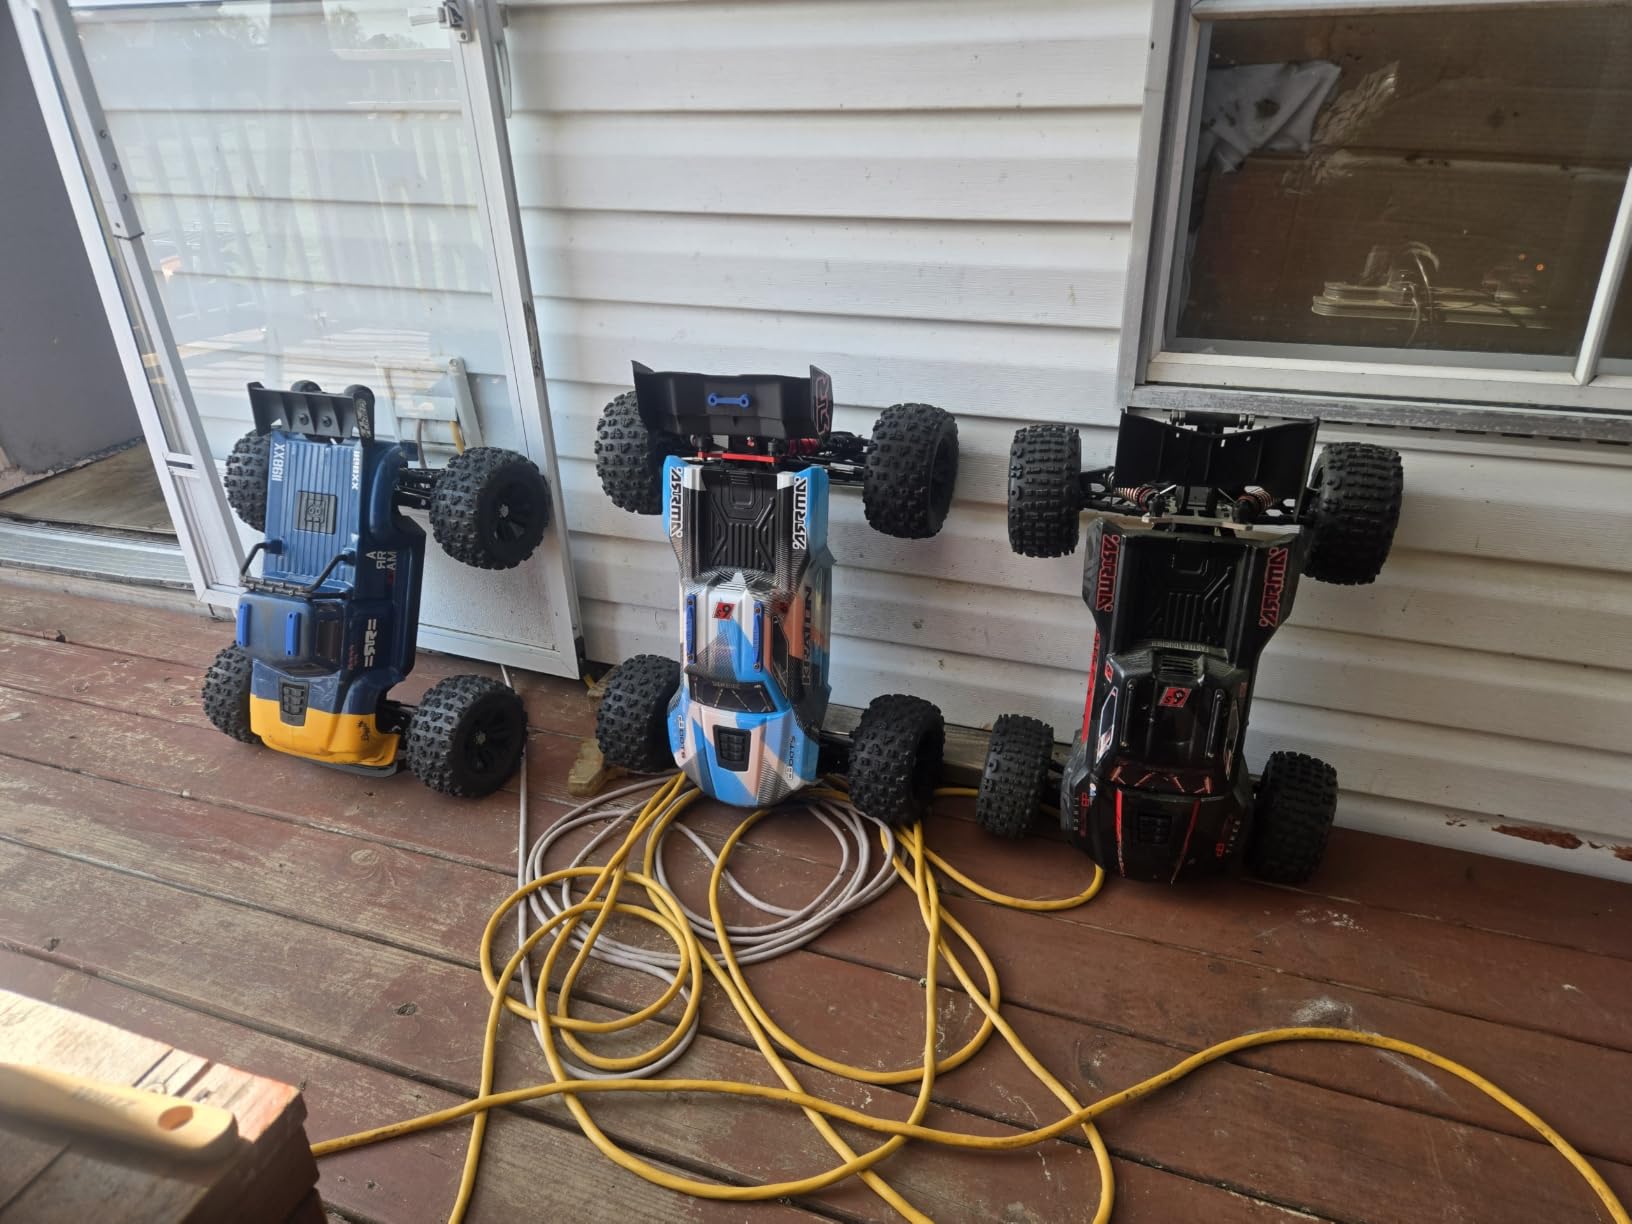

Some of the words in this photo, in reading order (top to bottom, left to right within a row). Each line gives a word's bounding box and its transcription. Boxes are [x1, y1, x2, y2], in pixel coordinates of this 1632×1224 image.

[669, 466, 684, 538] ARRMA
[792, 477, 807, 549] ARRMA
[1096, 535, 1120, 612] ARRMA
[1259, 547, 1288, 627] ARRMA
